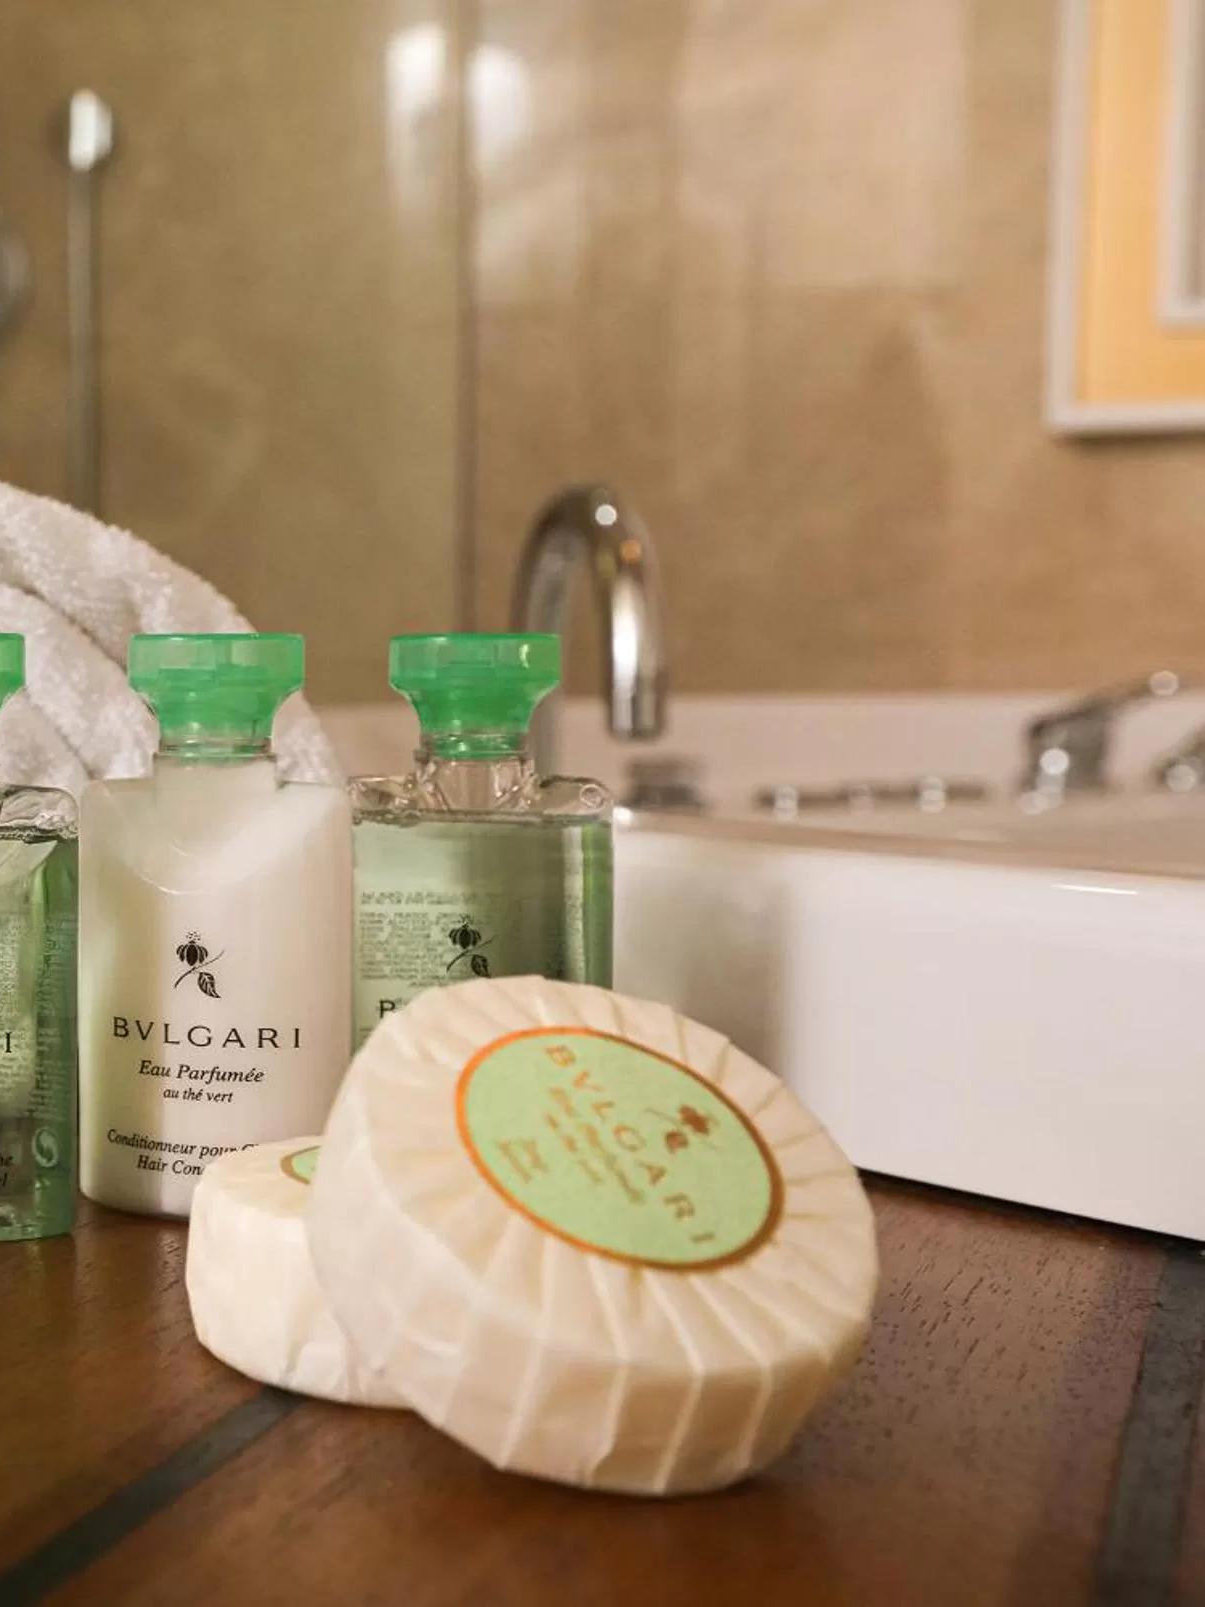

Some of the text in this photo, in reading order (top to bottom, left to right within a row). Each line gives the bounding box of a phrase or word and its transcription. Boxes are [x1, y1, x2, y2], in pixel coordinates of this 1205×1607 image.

[113, 1017, 301, 1049] BVLGARI
[138, 1060, 264, 1086] Eau Parfumée
[163, 1088, 233, 1103] au thé vert
[107, 1129, 196, 1155] Conditionneur
[544, 1045, 716, 1244] BVLGARI
[137, 1155, 168, 1172] Hair
